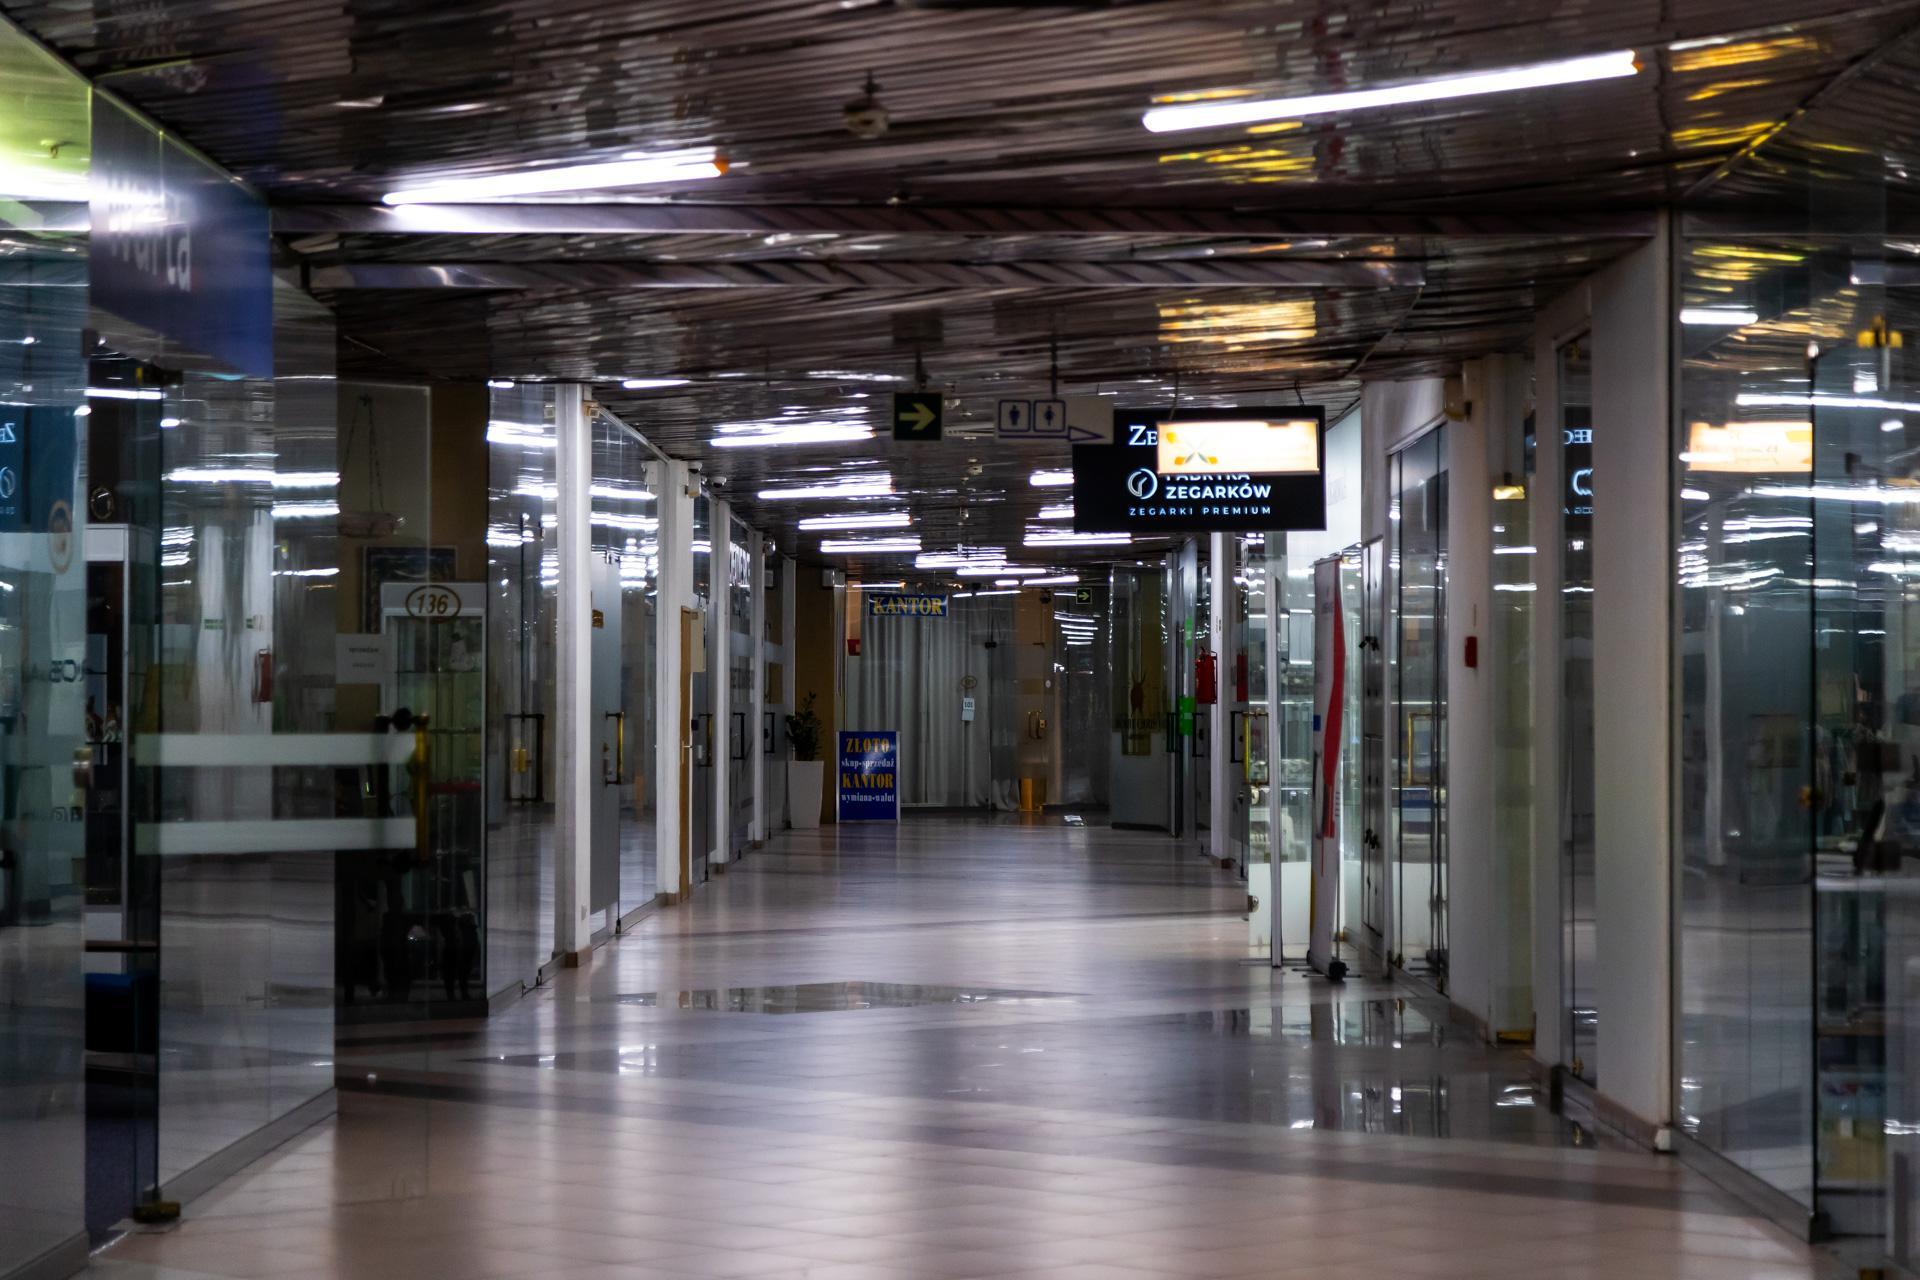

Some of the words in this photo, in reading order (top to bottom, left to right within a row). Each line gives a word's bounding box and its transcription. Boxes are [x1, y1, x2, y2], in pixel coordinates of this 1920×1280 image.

[1165, 483, 1272, 499] ZEGARKÓW
[1129, 507, 1194, 516] ZEGARKI
[1203, 506, 1271, 515] PREMIUM
[417, 593, 449, 615] 136
[873, 596, 943, 616] KANTOR
[842, 773, 894, 789] KANTOR
